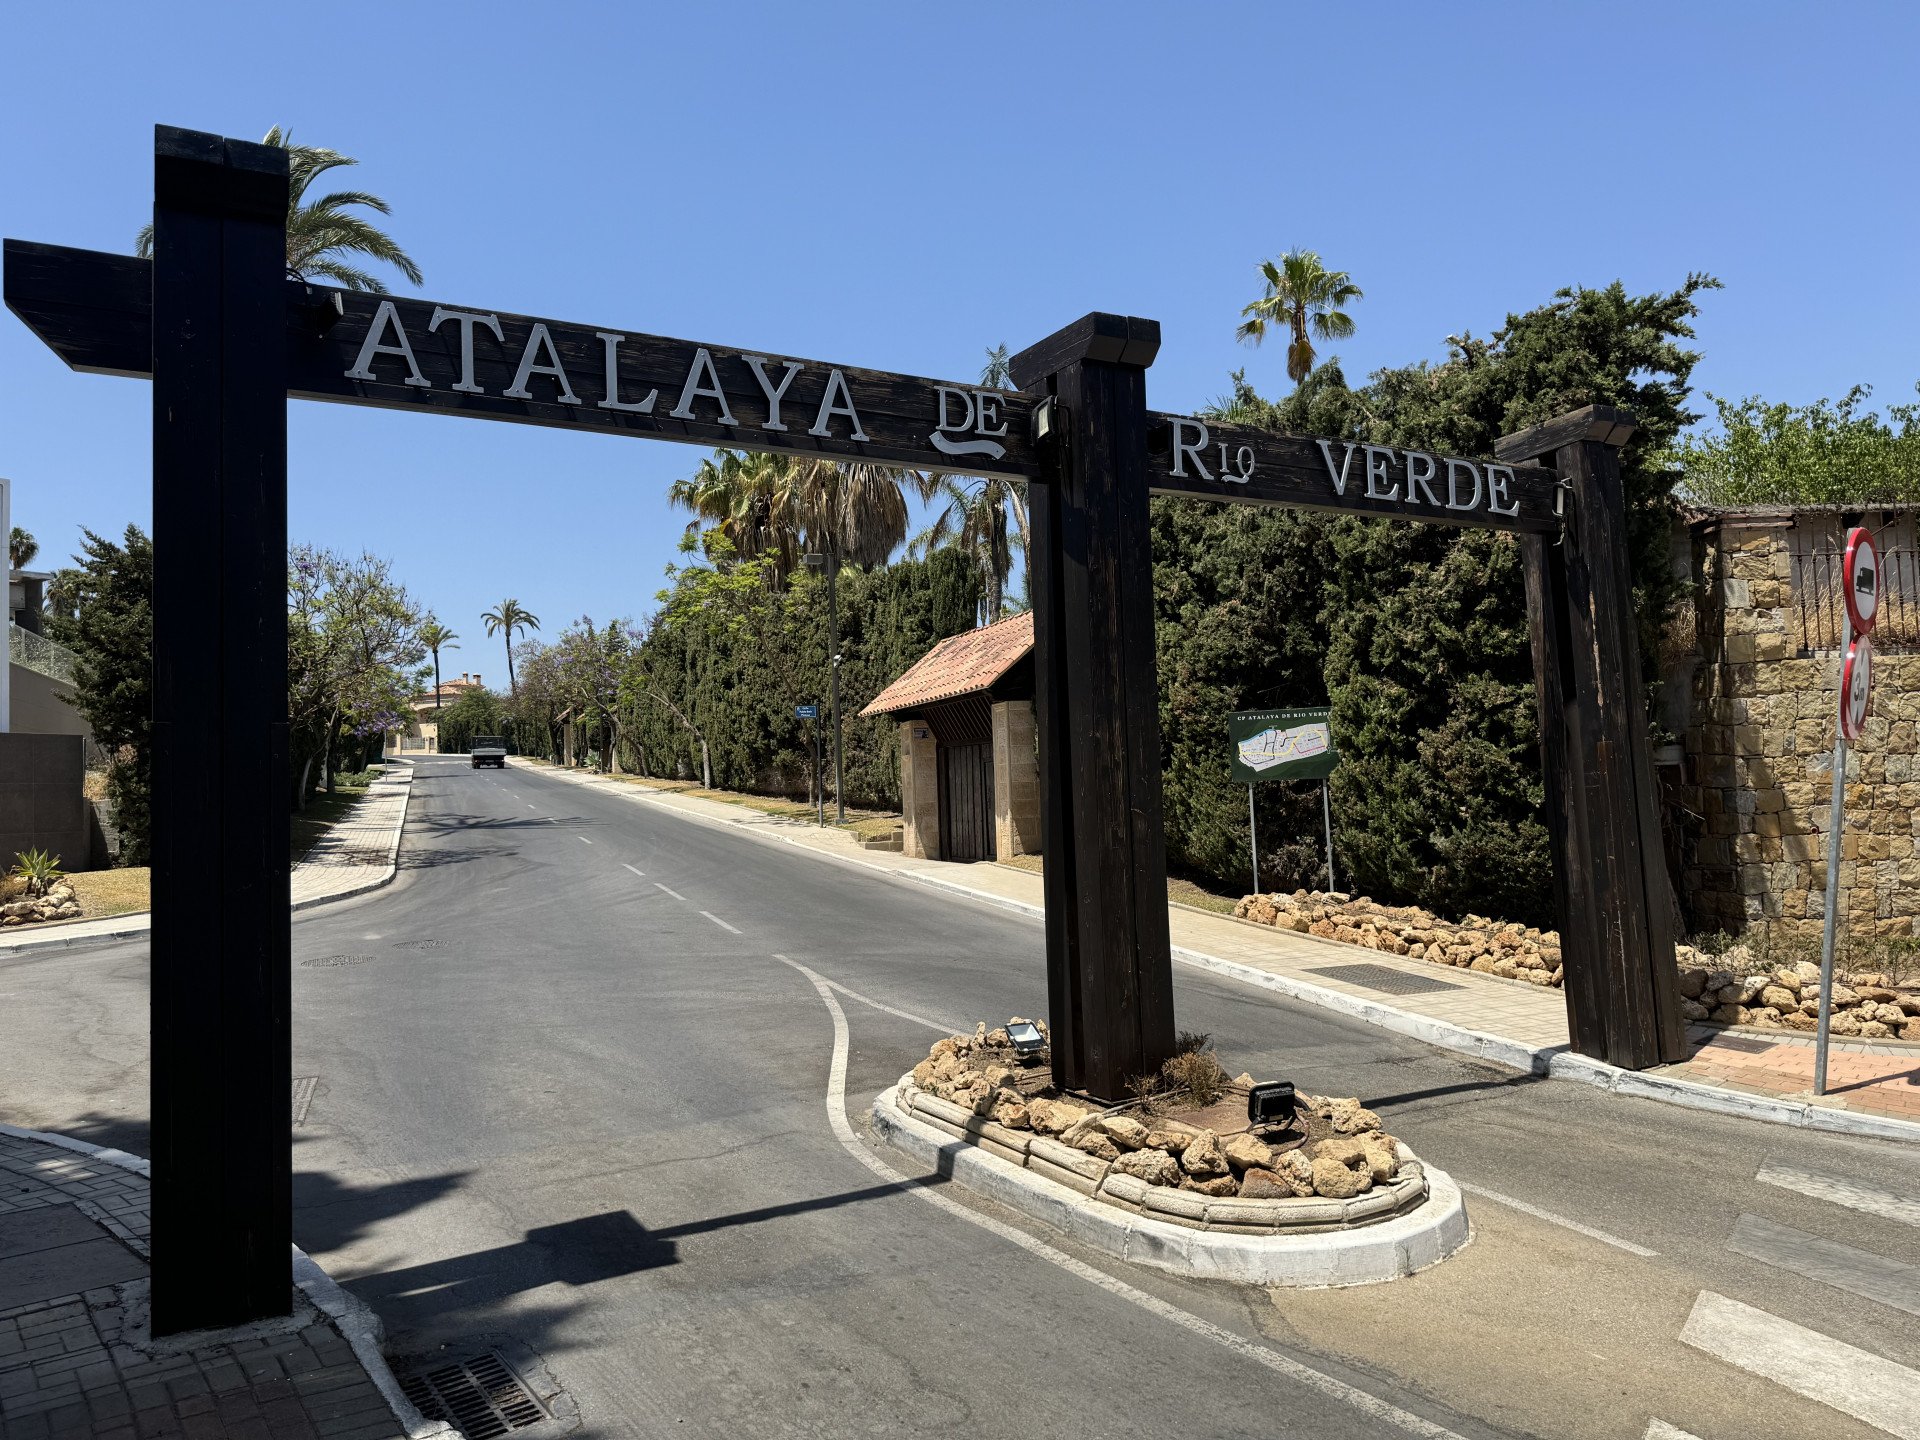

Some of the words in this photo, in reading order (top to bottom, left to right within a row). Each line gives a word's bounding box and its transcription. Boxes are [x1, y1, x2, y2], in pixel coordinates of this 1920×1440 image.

[344, 300, 870, 442] ATALAYA
[933, 385, 1009, 437] DE
[1315, 439, 1521, 518] VERDE
